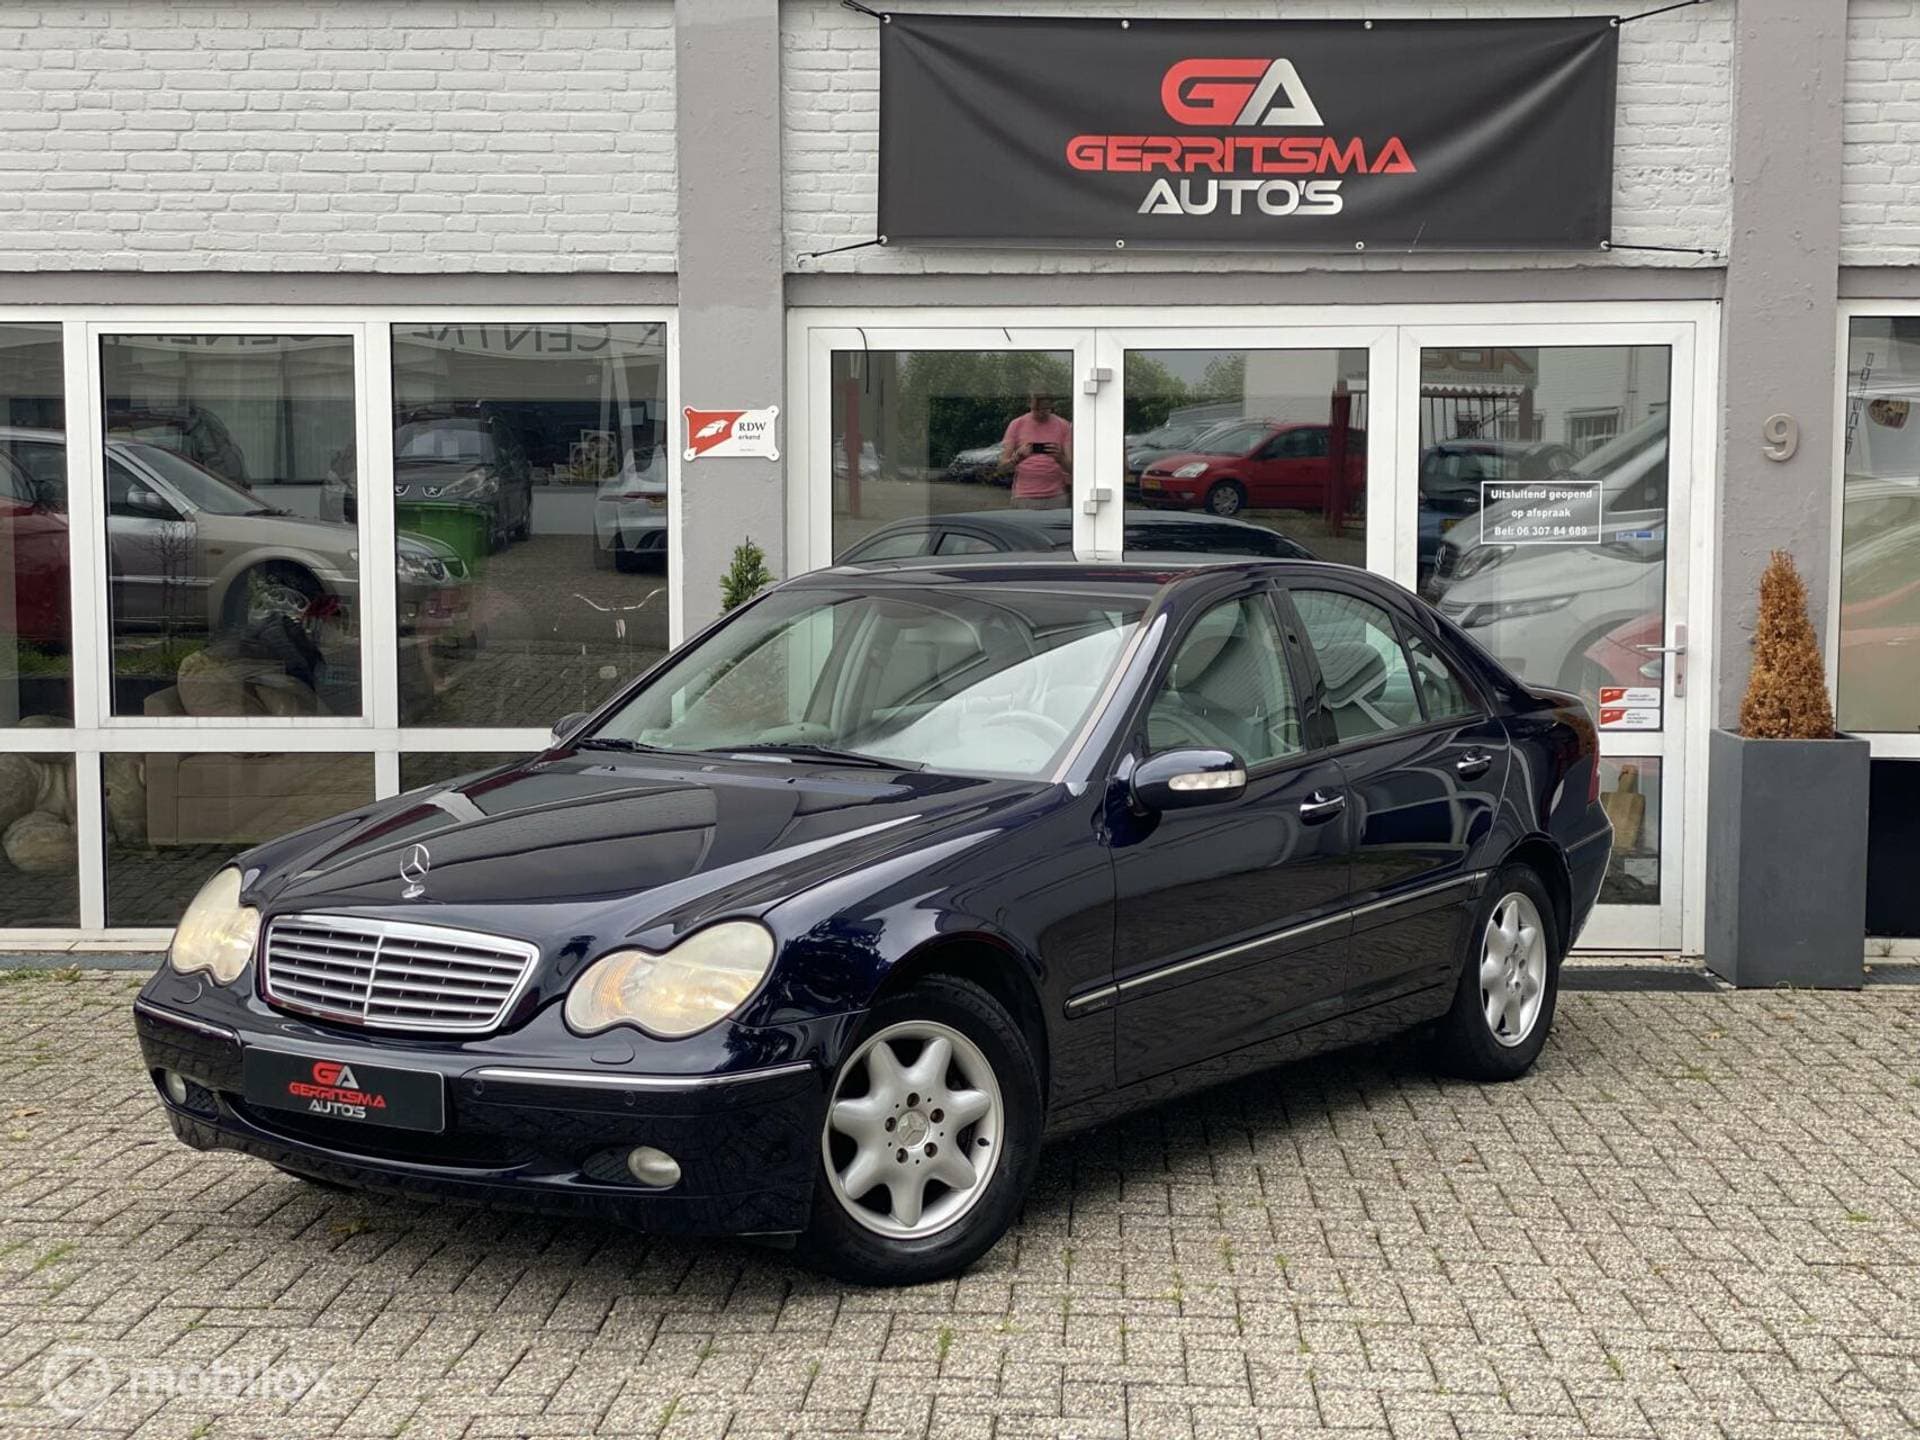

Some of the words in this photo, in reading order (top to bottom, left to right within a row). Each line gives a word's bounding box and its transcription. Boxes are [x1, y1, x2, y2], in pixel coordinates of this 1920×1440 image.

[1161, 58, 1324, 126] GA
[1066, 136, 1417, 174] GERRITSMA
[1137, 178, 1343, 215] AUTO'S
[739, 422, 766, 431] RDW
[1762, 413, 1798, 462] 9
[1491, 490, 1546, 499] Uitsluitend
[1549, 490, 1592, 501] geopend
[1512, 510, 1523, 519] op
[1526, 508, 1571, 518] afspraak
[1495, 526, 1513, 536] Bel:
[1517, 526, 1529, 536] 06
[1533, 526, 1550, 536] 307
[1554, 526, 1565, 536] 84
[312, 1062, 359, 1088] GA
[288, 1082, 386, 1108] GERRITSMA
